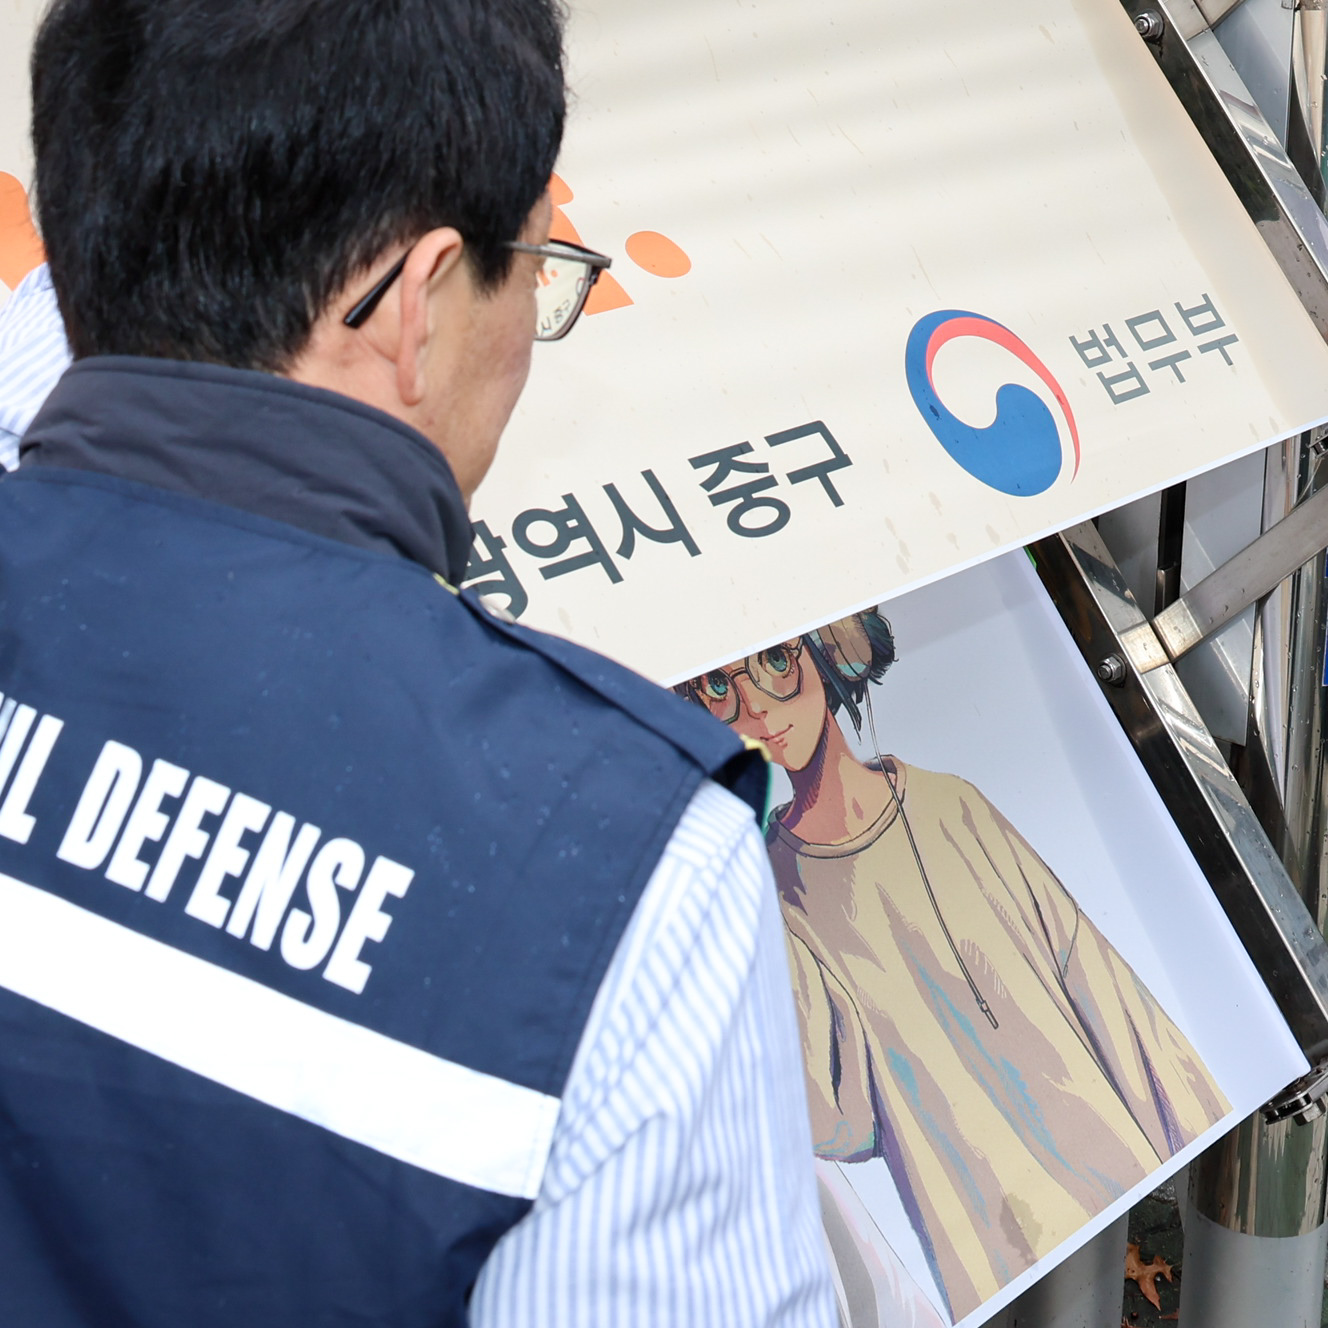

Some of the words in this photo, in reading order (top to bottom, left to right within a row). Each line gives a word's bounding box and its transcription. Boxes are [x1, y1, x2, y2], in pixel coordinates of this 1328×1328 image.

[1069, 293, 1240, 405] 법무부
[688, 419, 854, 539] 중구
[56, 739, 416, 995] DEFENSE
